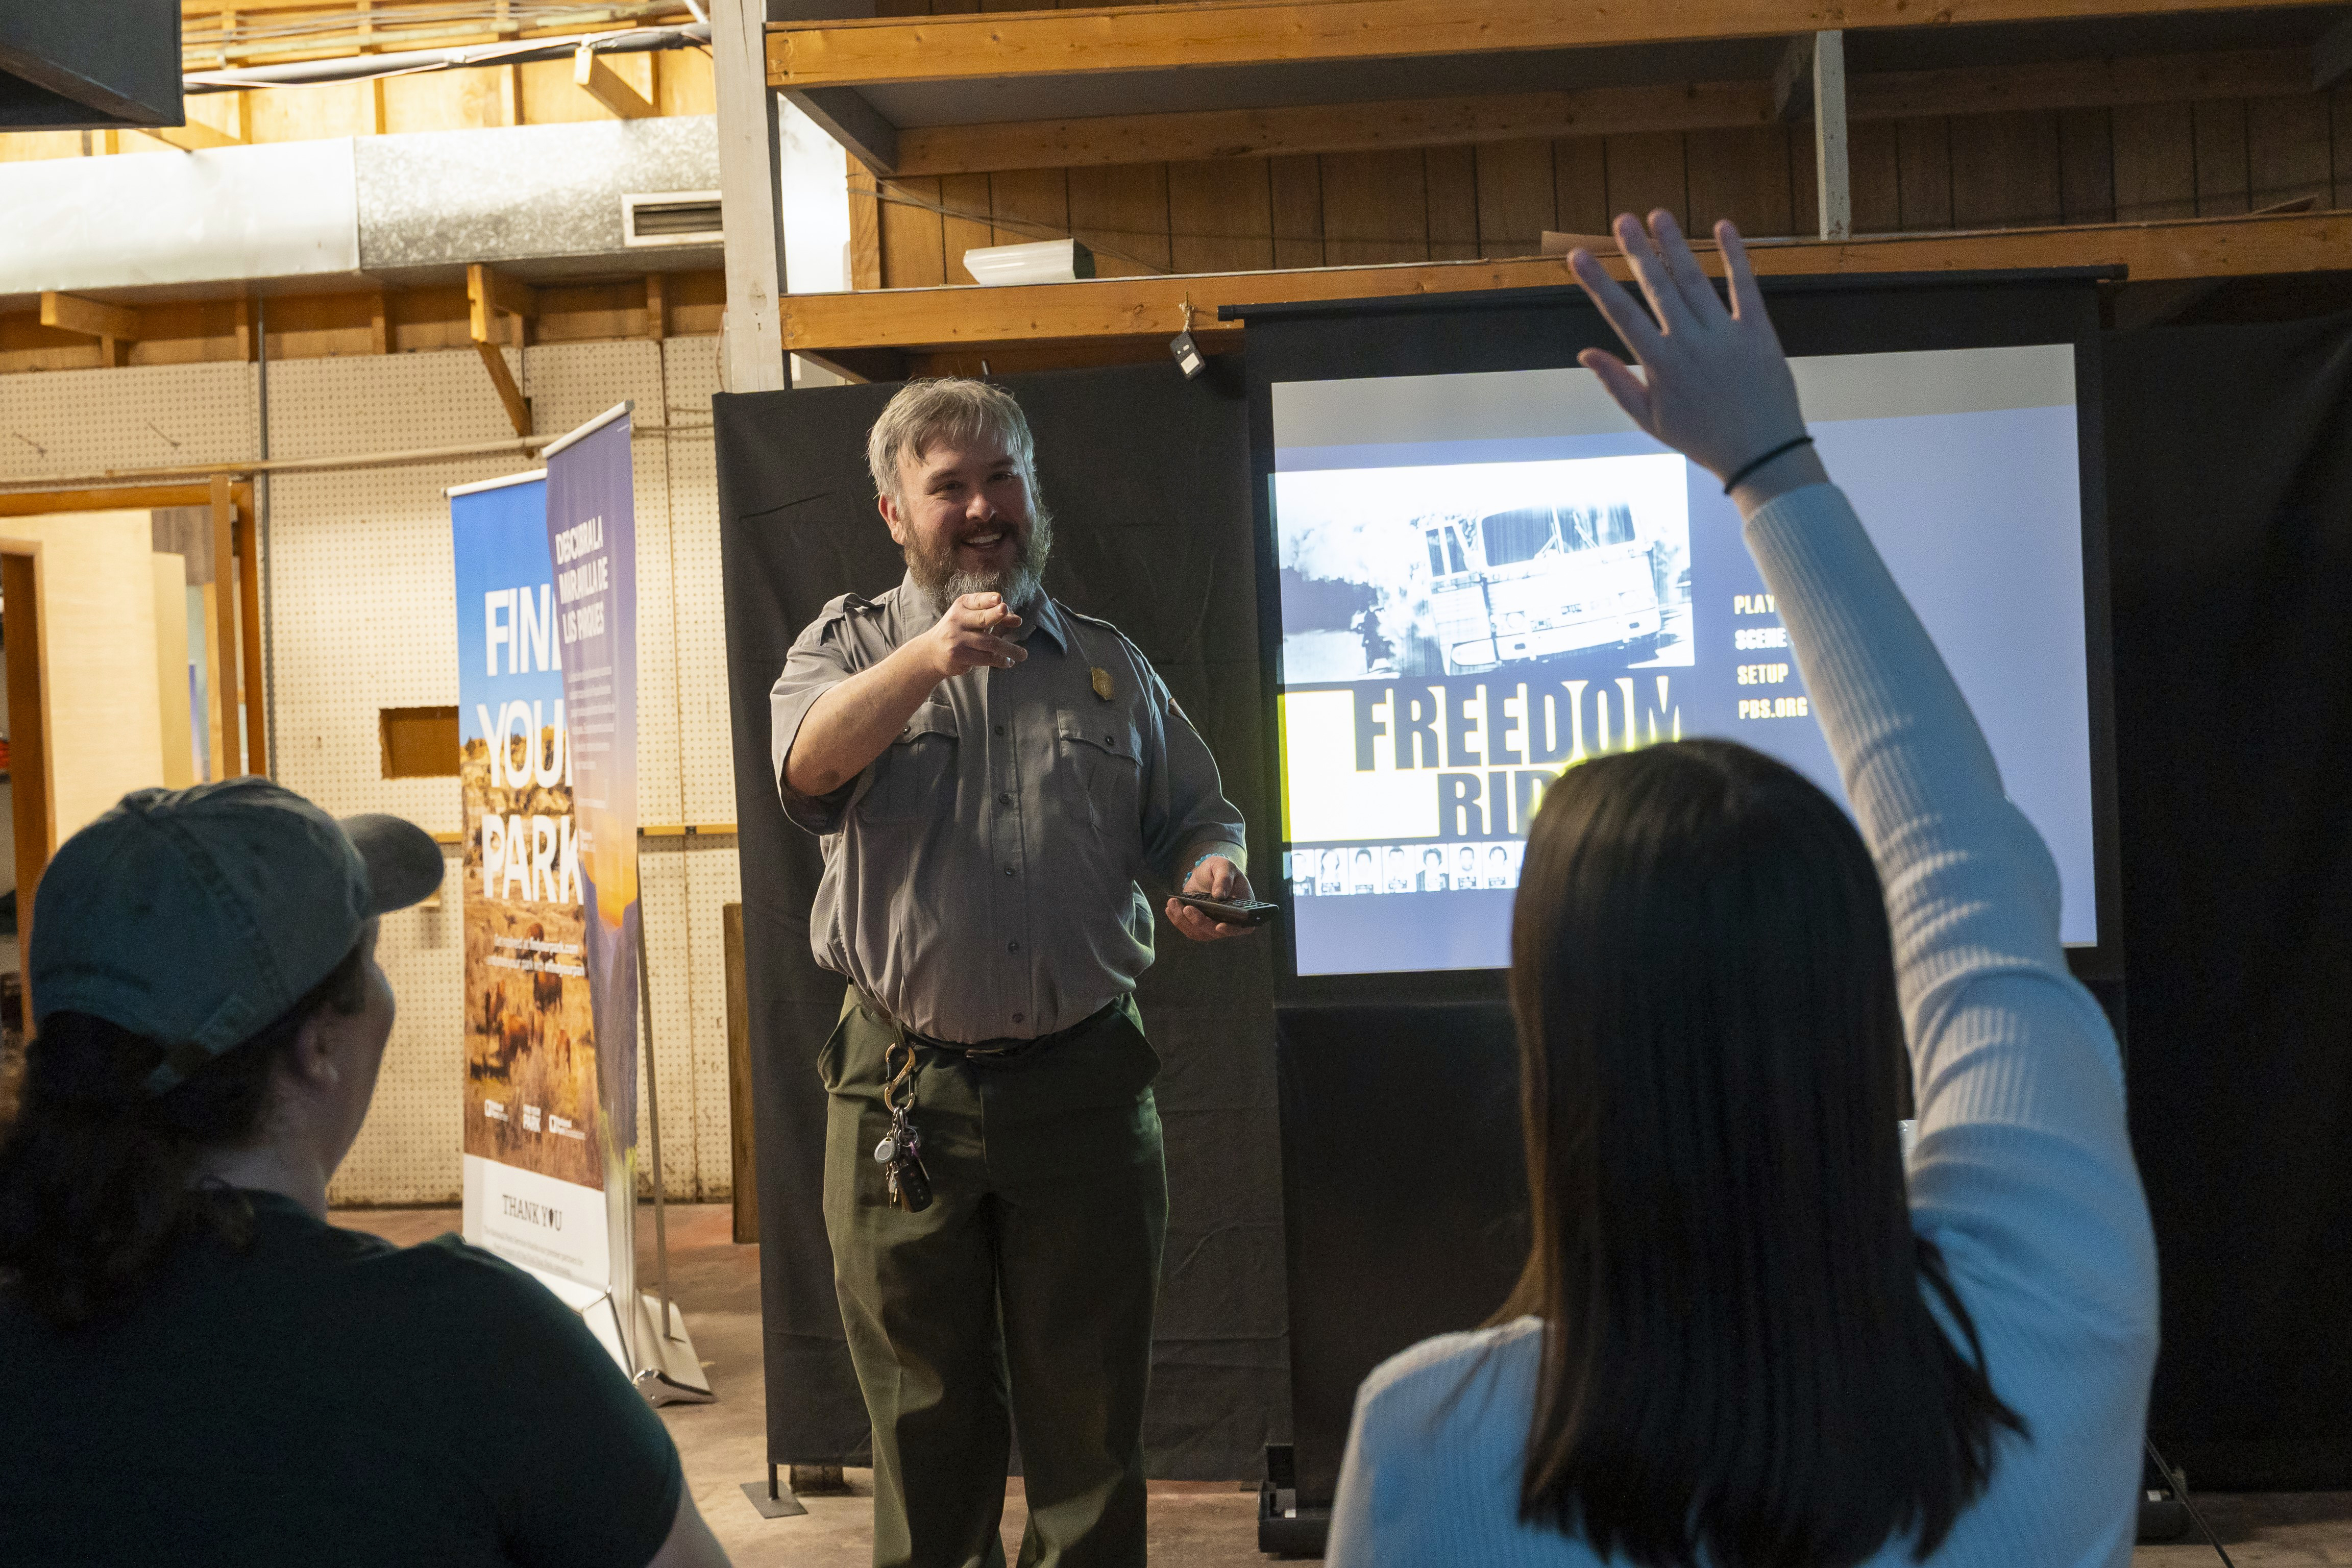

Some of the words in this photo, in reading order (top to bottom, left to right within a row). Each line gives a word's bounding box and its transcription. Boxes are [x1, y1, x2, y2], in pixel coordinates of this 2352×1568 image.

[1734, 594, 1775, 614] PLAY
[1735, 627, 1787, 650] SCENE
[1737, 663, 1788, 685] SETUP
[1738, 697, 1808, 720] PBS.ORG
[1353, 676, 1694, 771] FREEDOM
[1437, 770, 1561, 837] RID
[481, 814, 584, 905] PARK
[502, 1193, 539, 1225] THANK
